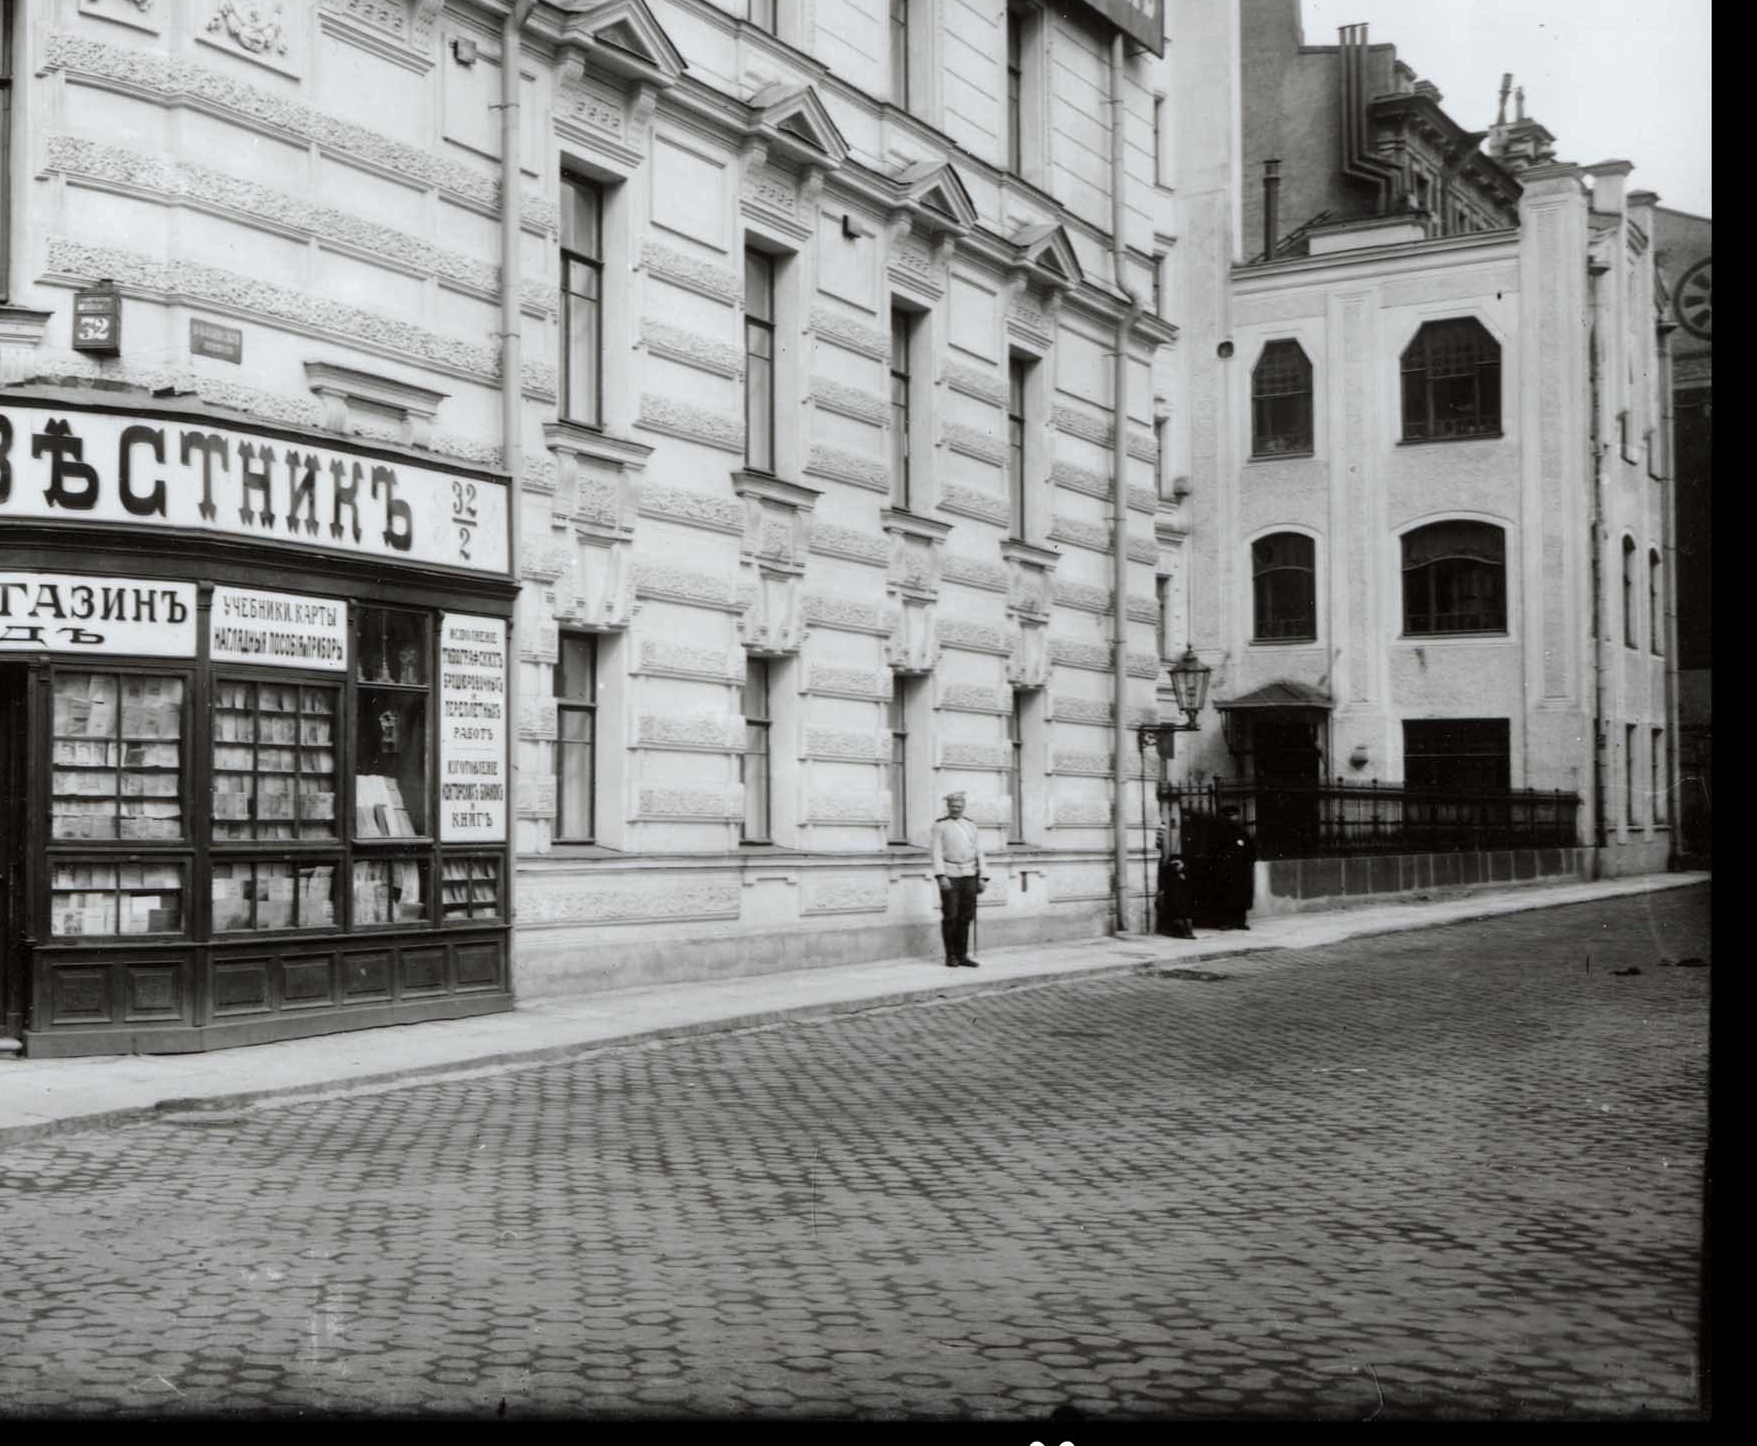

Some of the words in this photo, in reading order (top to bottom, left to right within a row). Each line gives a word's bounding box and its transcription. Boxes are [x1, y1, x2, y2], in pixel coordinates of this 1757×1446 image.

[78, 317, 110, 340] 32
[452, 481, 477, 517] 32
[459, 527, 471, 560] 2
[295, 603, 337, 627] КАРТЫ
[453, 727, 494, 741] РАБОТЪ
[452, 812, 493, 828] КНИГЪ
